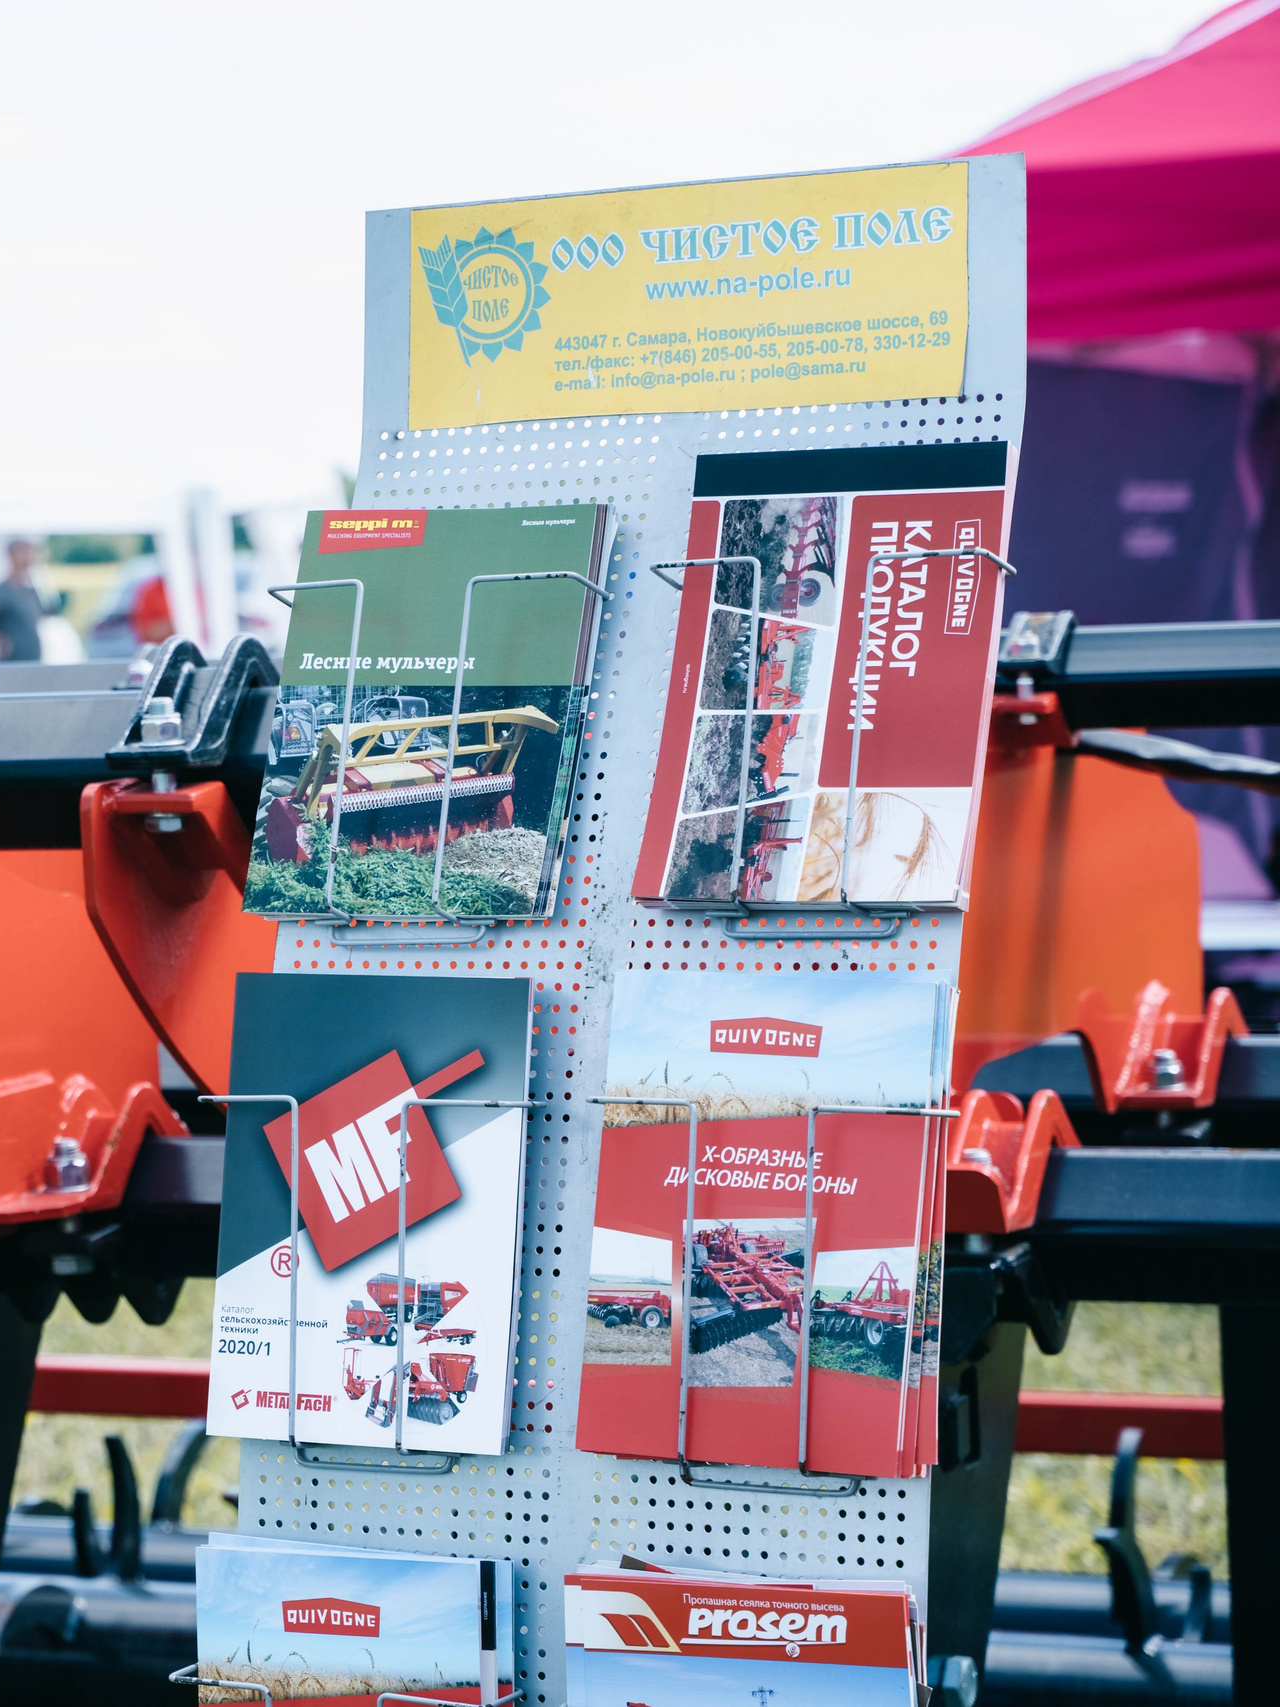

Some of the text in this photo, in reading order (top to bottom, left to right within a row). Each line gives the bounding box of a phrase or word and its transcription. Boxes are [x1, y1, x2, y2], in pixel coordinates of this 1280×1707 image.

[550, 205, 953, 274] ООО ЧИСТОЕ ПОЛЕ
[463, 265, 519, 290] ЧИСТОЕ
[645, 267, 852, 300] www.na-pole.ru
[472, 298, 510, 323] ПОЛЕ
[554, 310, 948, 351] 443047 г. Самара, Новокуйбышевское шоссе, 69
[554, 331, 951, 373] тел./факс: +7(846) 205-00-55, 205-00-78, 330-12-29
[554, 374, 605, 391] e-mal:
[611, 368, 735, 389] info@na-pole.ru
[751, 361, 866, 383] pole@sama.ru
[329, 518, 388, 531] seppi
[951, 527, 975, 628] QUIVOGNE
[889, 520, 933, 677] КАТАЛОГ
[847, 521, 899, 730] ПРОДУКЦИИ
[376, 656, 475, 674] мульчеры
[715, 1028, 817, 1047] QUIVOGNE
[304, 1087, 419, 1224] MF
[220, 1315, 328, 1329] сельскохозяйсвенной
[221, 1304, 254, 1315] Каталог
[220, 1325, 259, 1335] техники
[218, 1339, 271, 1356] 2020/1
[683, 1593, 844, 1612] Пропашная сеялка точного высева
[287, 1609, 376, 1627] QUIVOGNE
